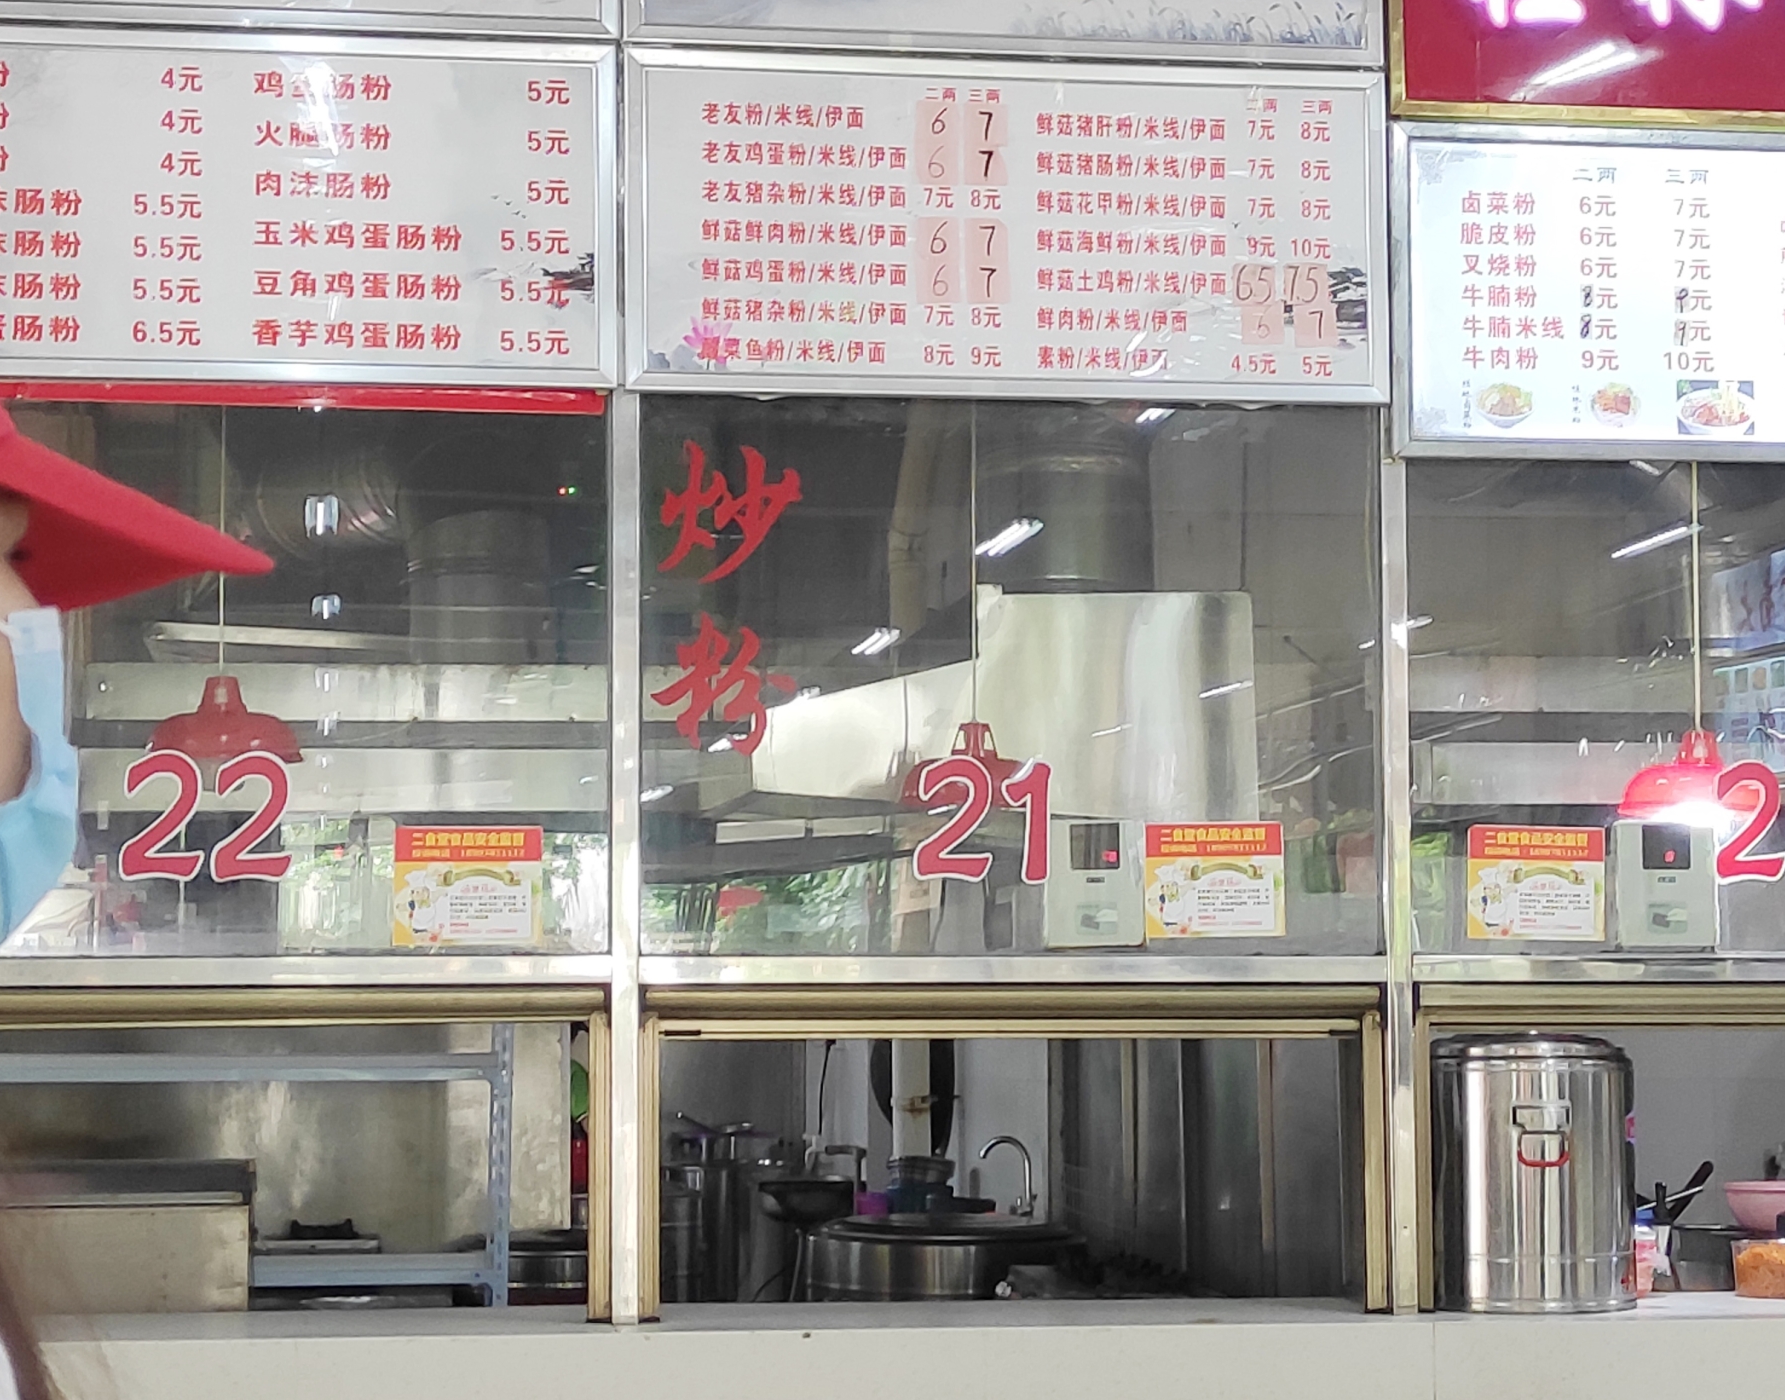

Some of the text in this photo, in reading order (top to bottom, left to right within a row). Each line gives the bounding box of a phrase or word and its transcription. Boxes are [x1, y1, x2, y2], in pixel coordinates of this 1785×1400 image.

[160, 66, 203, 92] 4元
[527, 80, 571, 105] 5元
[160, 109, 203, 134] 4元
[1248, 120, 1275, 141] 7元
[1300, 121, 1331, 142] 8元
[527, 130, 571, 155] 5元
[160, 152, 203, 177] 4元
[978, 150, 994, 181] 7
[1248, 159, 1275, 180] 7元
[1300, 160, 1331, 181] 8元
[527, 181, 571, 205] 5元
[924, 188, 954, 208] 7元
[970, 189, 1002, 210] 8元
[1462, 190, 1536, 216] 卤菜粉
[1579, 195, 1617, 217] 6元
[133, 193, 203, 219] 5.5元
[1248, 198, 1276, 219] 7元
[1301, 199, 1332, 220] 8元
[254, 221, 571, 255] 玉米鸡蛋肠粉 5.5元
[1460, 222, 1536, 246] 脆皮粉
[1579, 227, 1617, 247] 6元
[133, 236, 202, 261] 5.5元
[1291, 238, 1332, 259] 10元
[1461, 254, 1537, 278] 叉烧粉
[1580, 257, 1618, 278] 6元
[133, 278, 202, 304] 5.5元
[253, 270, 571, 305] 豆角鸡蛋肠粉 5.5元
[979, 267, 997, 298] 7
[924, 305, 955, 327] 7元
[971, 307, 1002, 329] 8元
[1308, 310, 1323, 339] 7
[133, 320, 201, 346] 6.5元
[253, 319, 571, 356] 香芋鸡蛋肠粉 5.5元
[924, 346, 1002, 368] 8元 9元
[1302, 356, 1333, 376] 5元
[1463, 346, 1715, 373] 牛肉粉 9元 10元
[650, 439, 803, 756] 炒粉
[119, 750, 294, 882] 22
[914, 754, 1053, 885] 21
